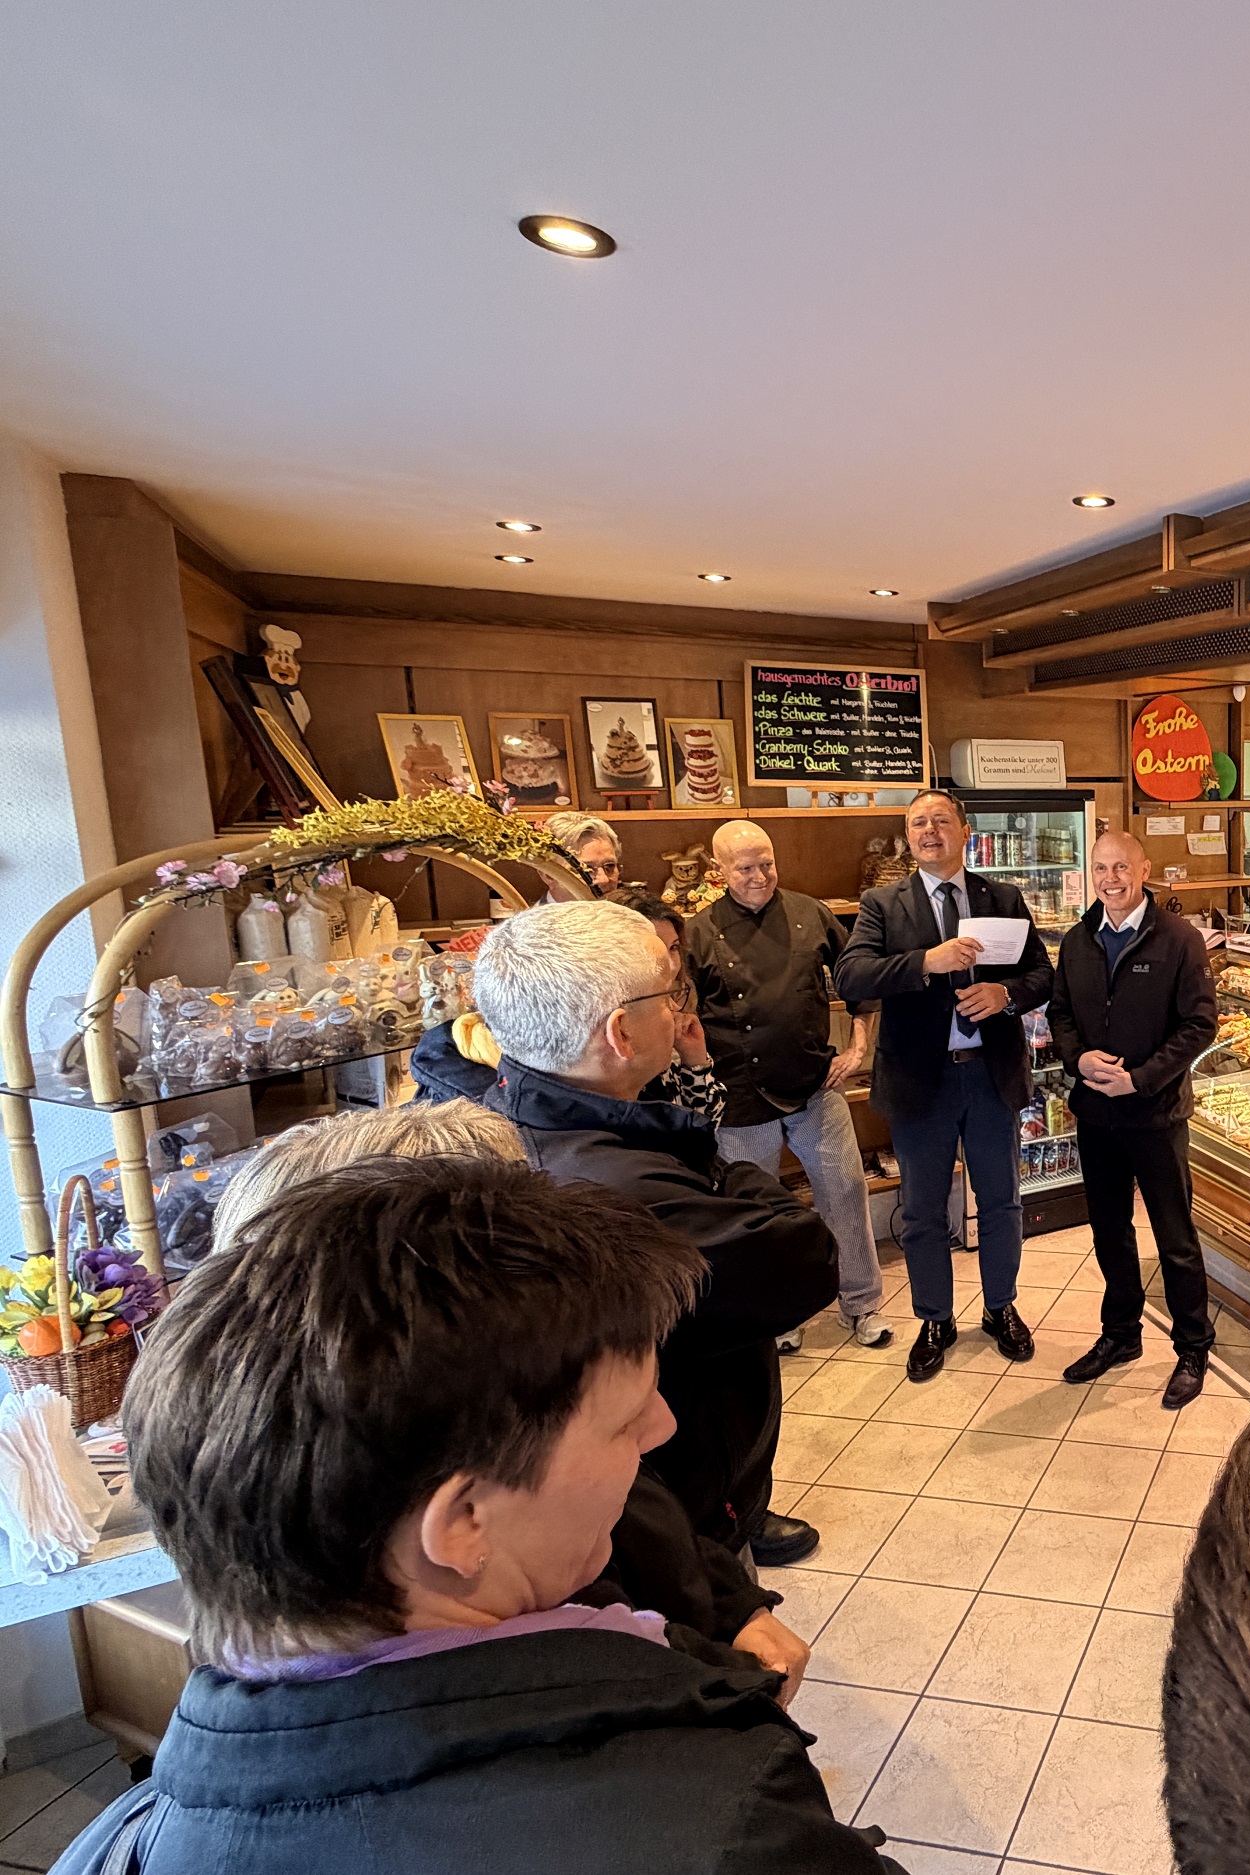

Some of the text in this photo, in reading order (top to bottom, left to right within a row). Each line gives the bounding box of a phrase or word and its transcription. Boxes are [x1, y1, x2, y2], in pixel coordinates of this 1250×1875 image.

[758, 669, 842, 687] hausgemachtes
[758, 690, 778, 703] das
[781, 690, 823, 707] Leichte
[757, 706, 778, 719] das
[781, 706, 829, 722] Schwere
[759, 722, 793, 736] Pinza
[1141, 707, 1199, 739] Frohe
[893, 746, 913, 754] Quark
[759, 755, 796, 769] Dinkel
[804, 756, 841, 771] Quark
[980, 756, 1026, 764] Kuchenstücke
[1136, 748, 1210, 775] Ostern
[983, 766, 1011, 774] Gramm
[1012, 766, 1026, 774] sind
